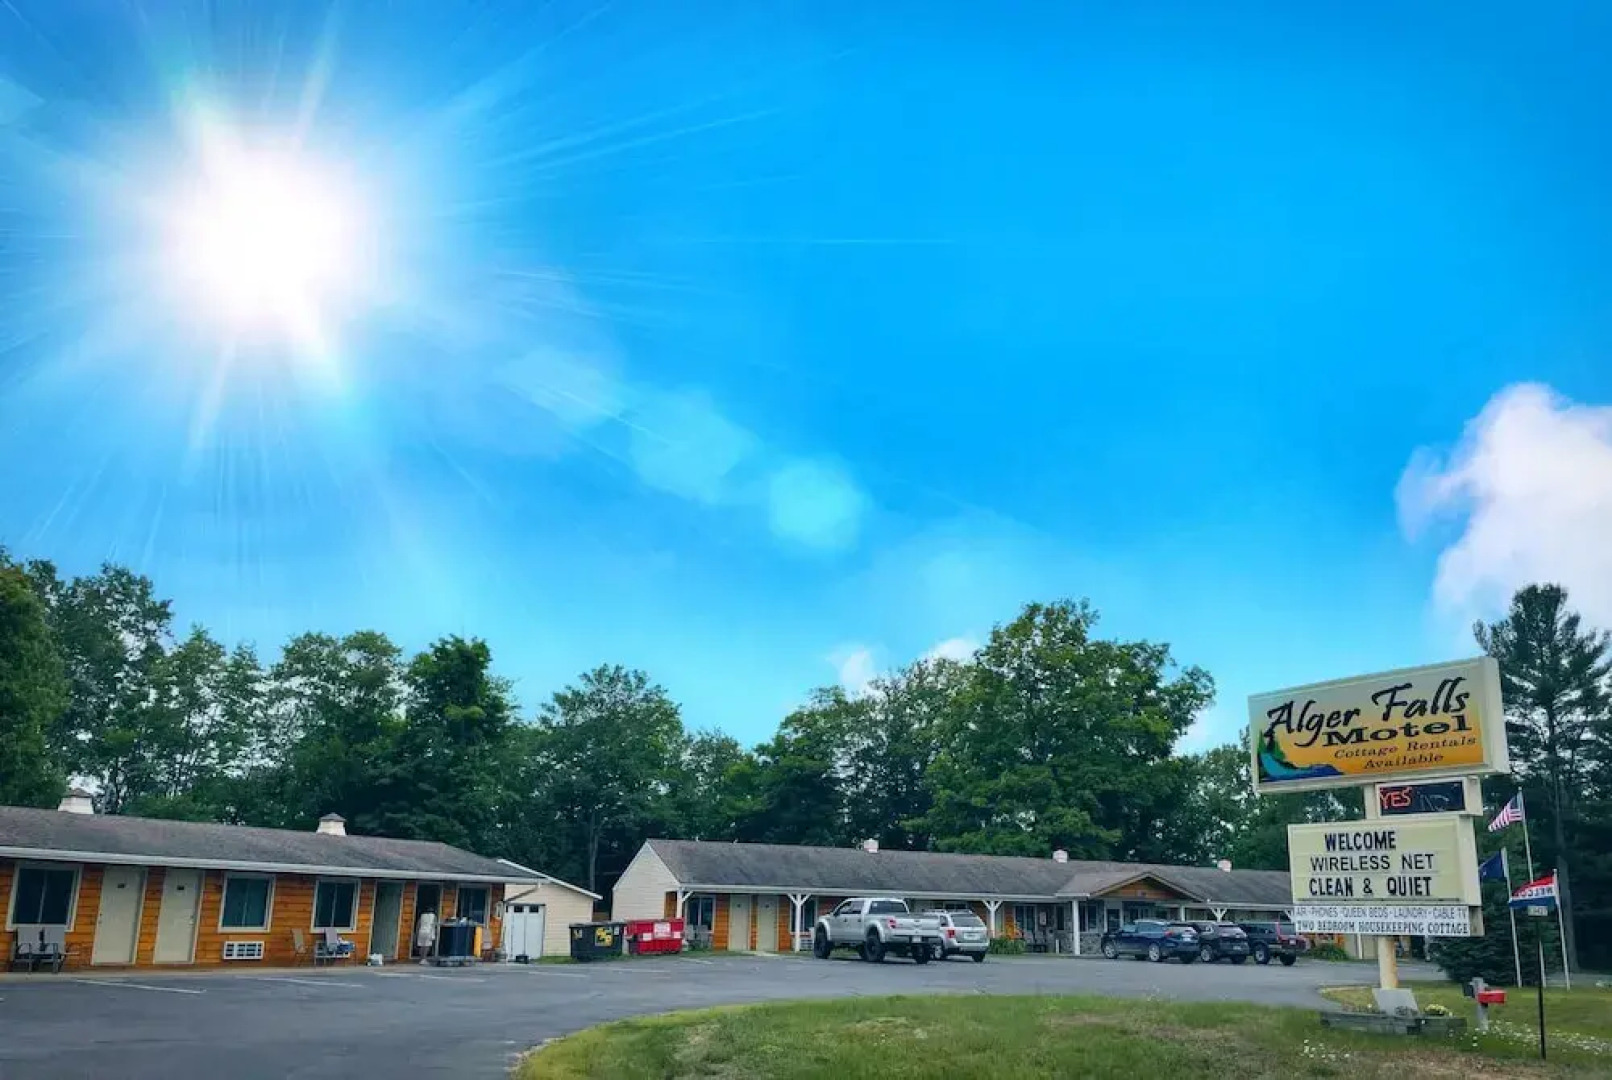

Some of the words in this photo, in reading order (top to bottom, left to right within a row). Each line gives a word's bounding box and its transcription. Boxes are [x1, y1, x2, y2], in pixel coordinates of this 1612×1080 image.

[1264, 700, 1360, 747] Alger
[1371, 676, 1470, 721] Falls
[1322, 714, 1472, 747] Motel
[1334, 744, 1398, 759] Cottage
[1406, 736, 1476, 752] Rentals
[1364, 753, 1443, 770] Available
[1380, 786, 1412, 809] YES
[1324, 831, 1396, 851] WELCOME
[1310, 854, 1390, 871] WIRELESS
[1401, 853, 1434, 870] NET
[1309, 877, 1353, 896] CLEAN
[1363, 877, 1373, 894] &
[1387, 876, 1432, 896] QUIET
[1297, 920, 1314, 931] TWO
[1318, 921, 1354, 932] BEDROOM
[1359, 921, 1424, 933] HOUSEKEEPING
[1428, 922, 1468, 934] COTTAGE
